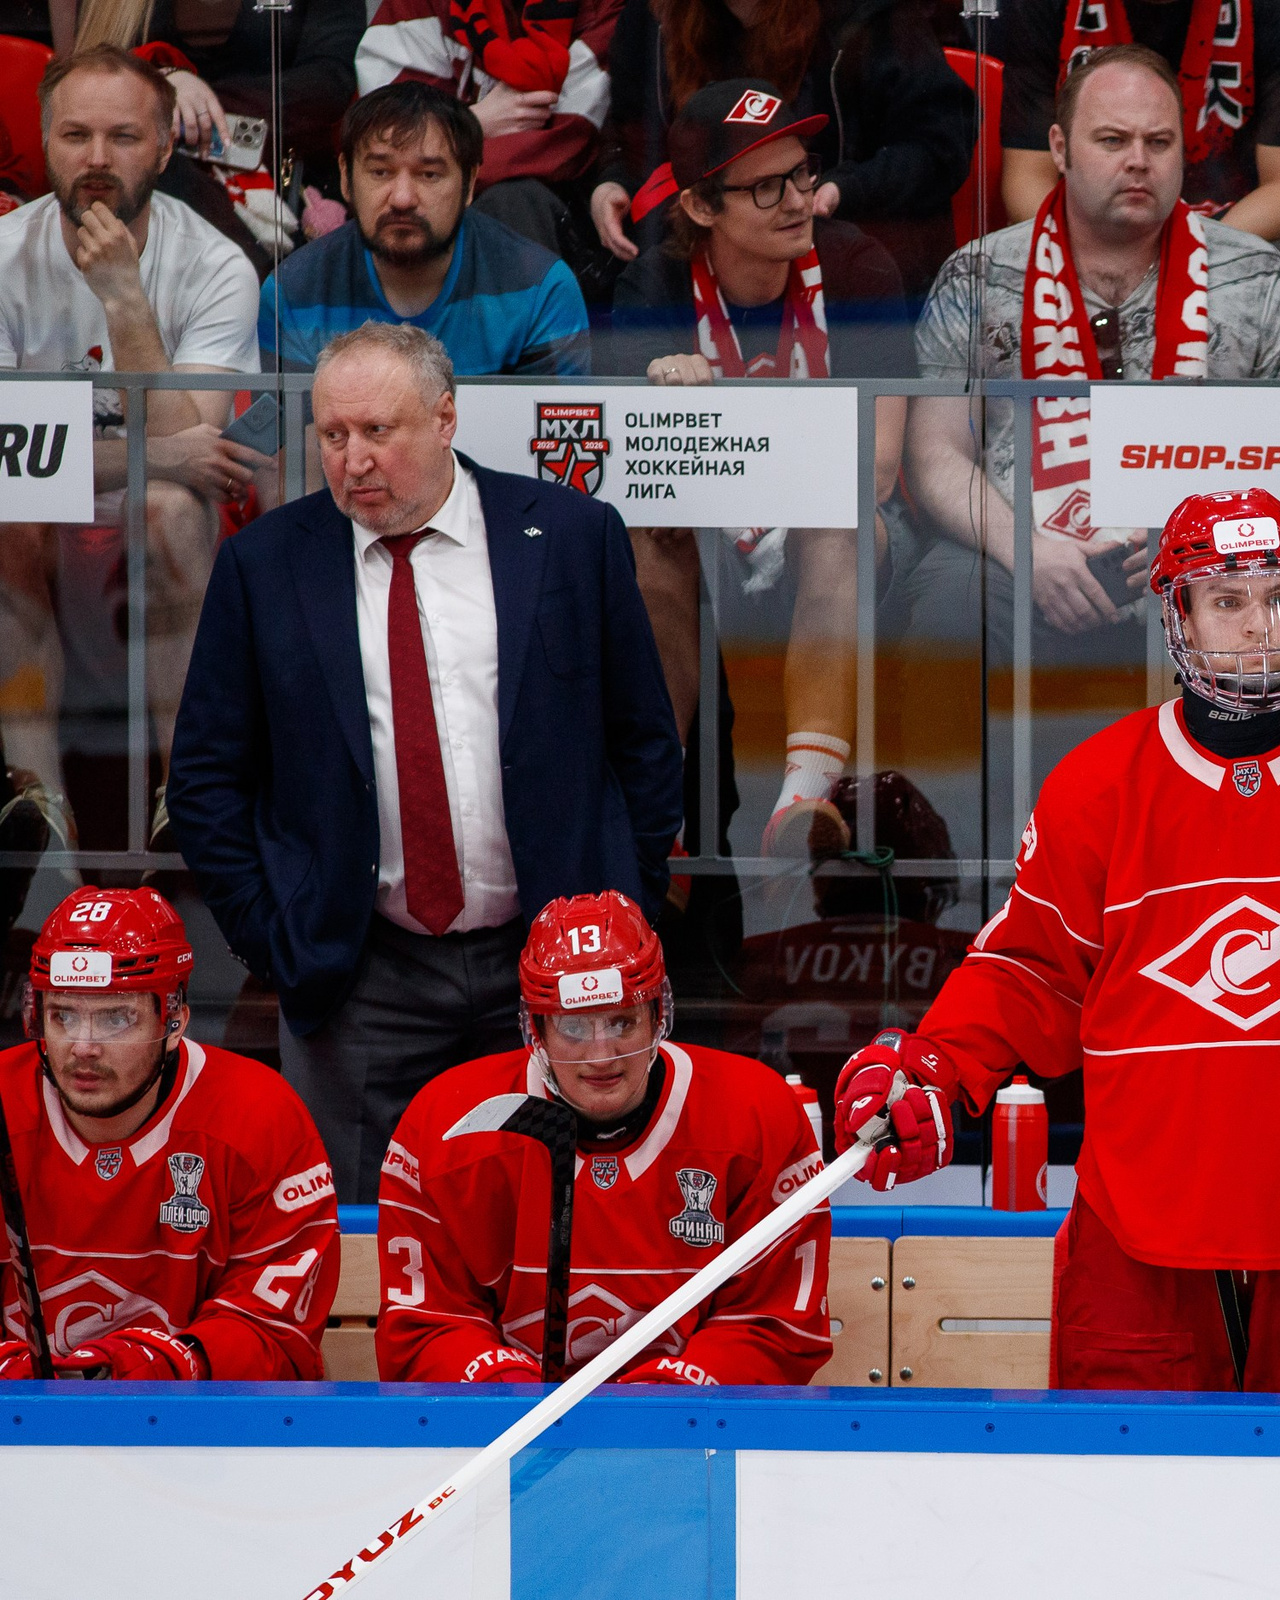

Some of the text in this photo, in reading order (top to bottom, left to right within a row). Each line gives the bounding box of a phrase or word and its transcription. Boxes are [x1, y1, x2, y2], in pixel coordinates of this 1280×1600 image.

[543, 408, 596, 417] OLIMPBET
[625, 412, 723, 428] OLIMPBET
[540, 419, 599, 439] МХЛ
[0, 423, 69, 478] RU
[536, 440, 555, 450] 2025
[584, 440, 604, 450] 2026
[625, 436, 770, 454] МОЛОДЕЖНАЯ
[625, 456, 745, 476] ХОККЕЙНАЯ
[625, 483, 677, 499] ЛИГА
[1220, 538, 1276, 551] OLIMPBET
[1208, 710, 1257, 722] BAUE
[1236, 767, 1257, 776] МХЛ
[69, 901, 113, 922] 28
[567, 925, 601, 956] 13
[54, 975, 107, 984] OLIMPBET
[565, 990, 619, 1005] OLIMPBET
[100, 1152, 119, 1160] МХЛ
[595, 1161, 615, 1169] МХЛ
[282, 1172, 334, 1202] OLIM
[162, 1205, 208, 1225] ПЛЕЙ-ОФФ
[671, 1219, 723, 1242] ФИНАЛ
[794, 1240, 826, 1316] 1
[428, 1485, 456, 1510] BC
